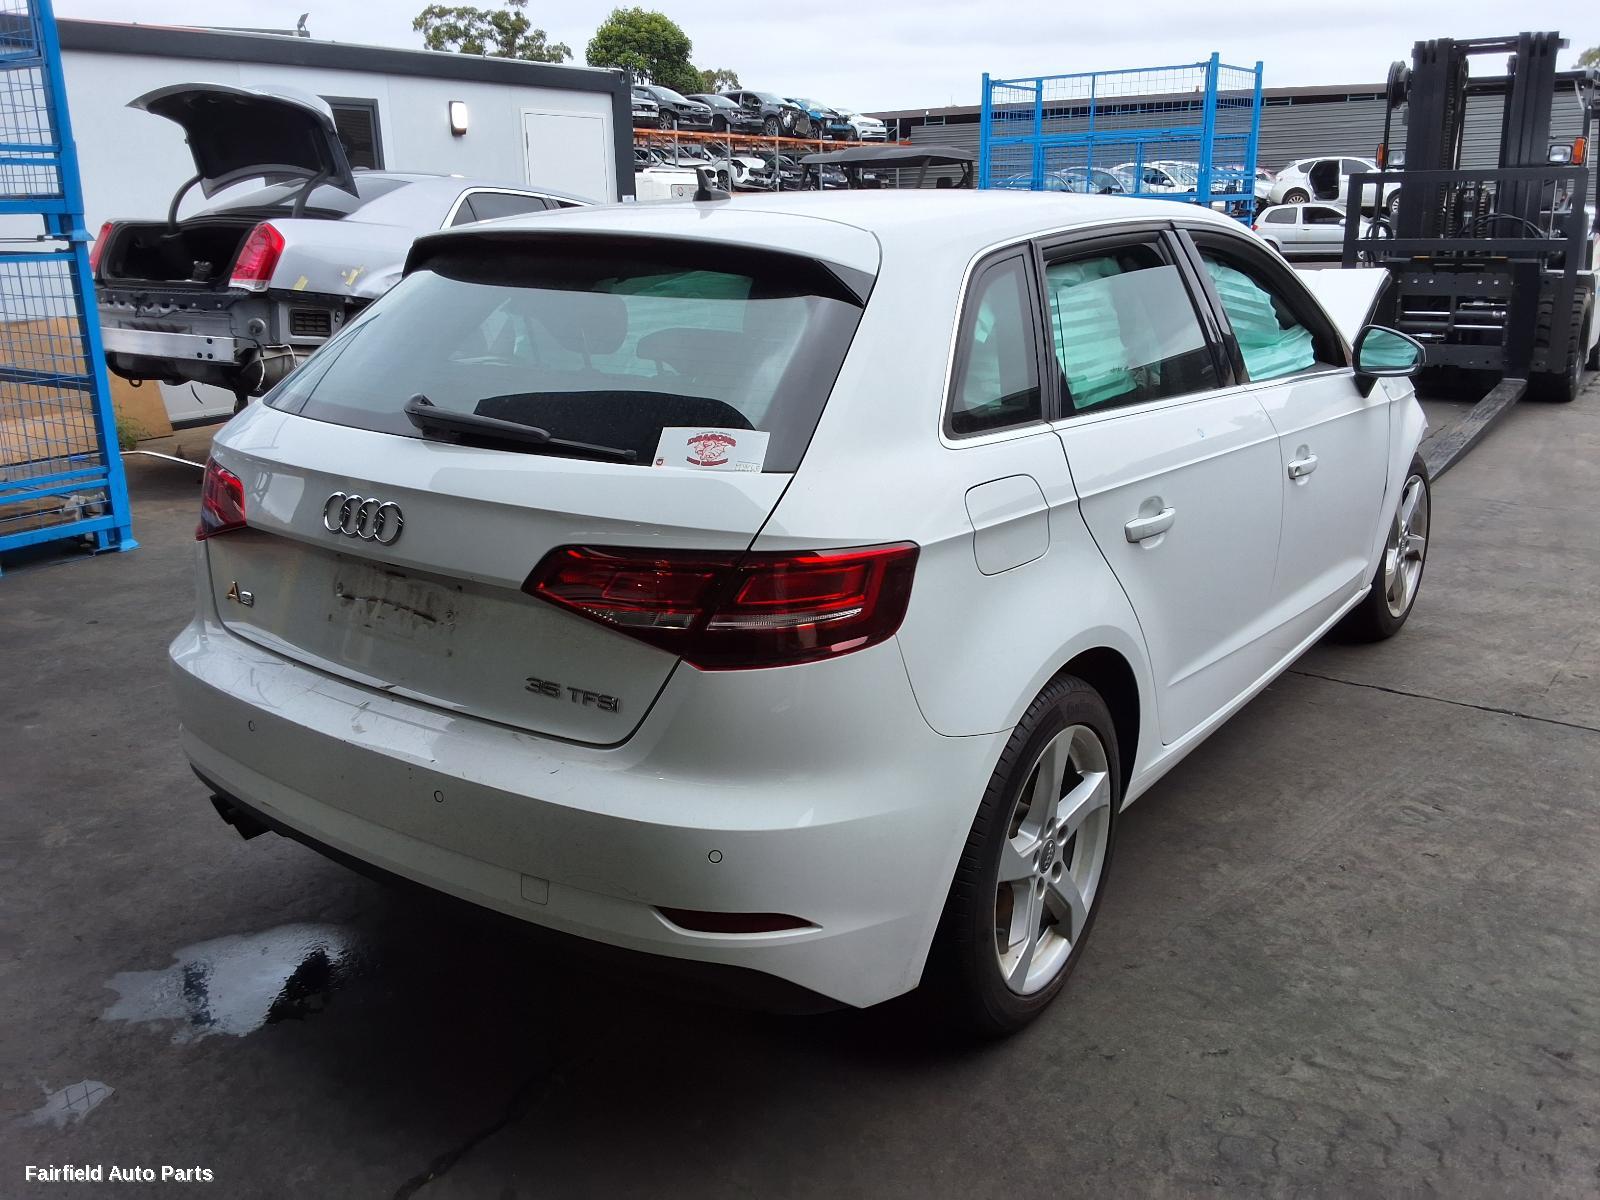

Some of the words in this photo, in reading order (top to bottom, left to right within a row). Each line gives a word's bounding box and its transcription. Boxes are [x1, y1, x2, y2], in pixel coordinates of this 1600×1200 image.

[225, 581, 255, 608] A3
[525, 677, 561, 698] 35
[567, 686, 620, 713] TFSI
